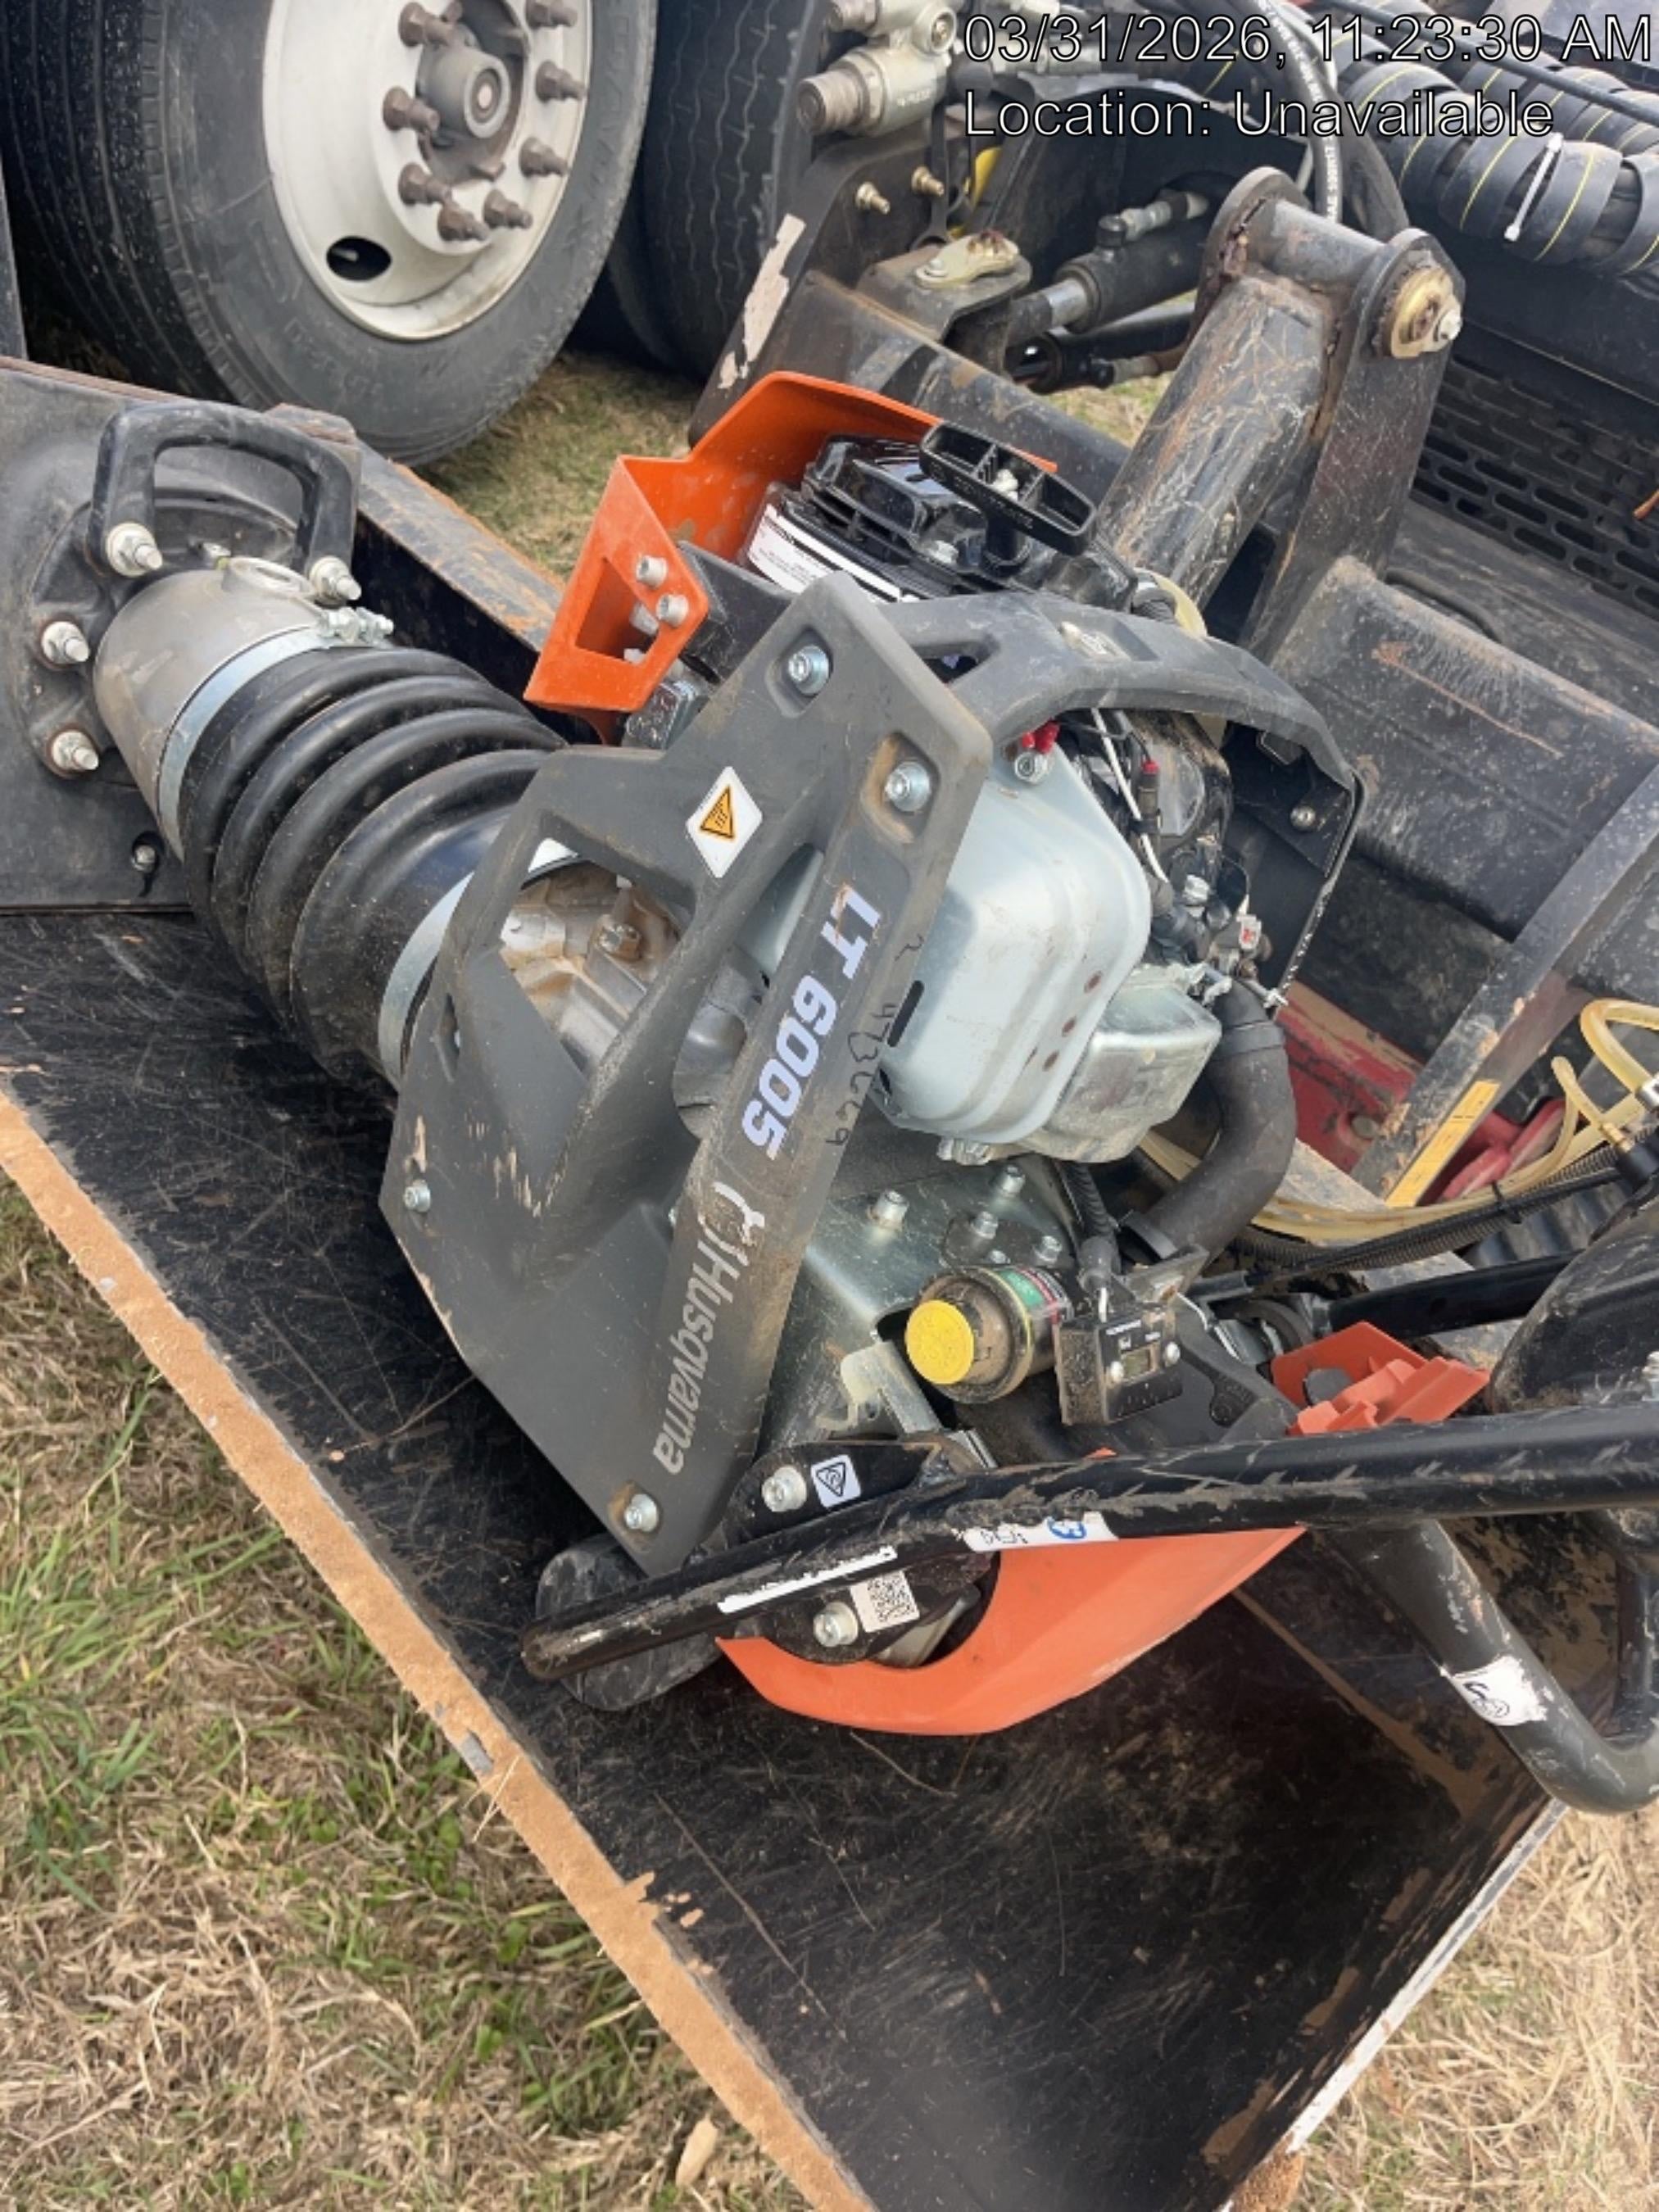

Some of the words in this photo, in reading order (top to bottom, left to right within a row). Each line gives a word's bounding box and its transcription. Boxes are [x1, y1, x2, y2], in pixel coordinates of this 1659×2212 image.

[821, 884, 882, 980] LT
[741, 974, 838, 1161] 6005
[653, 1239, 741, 1474] Husqvarna
